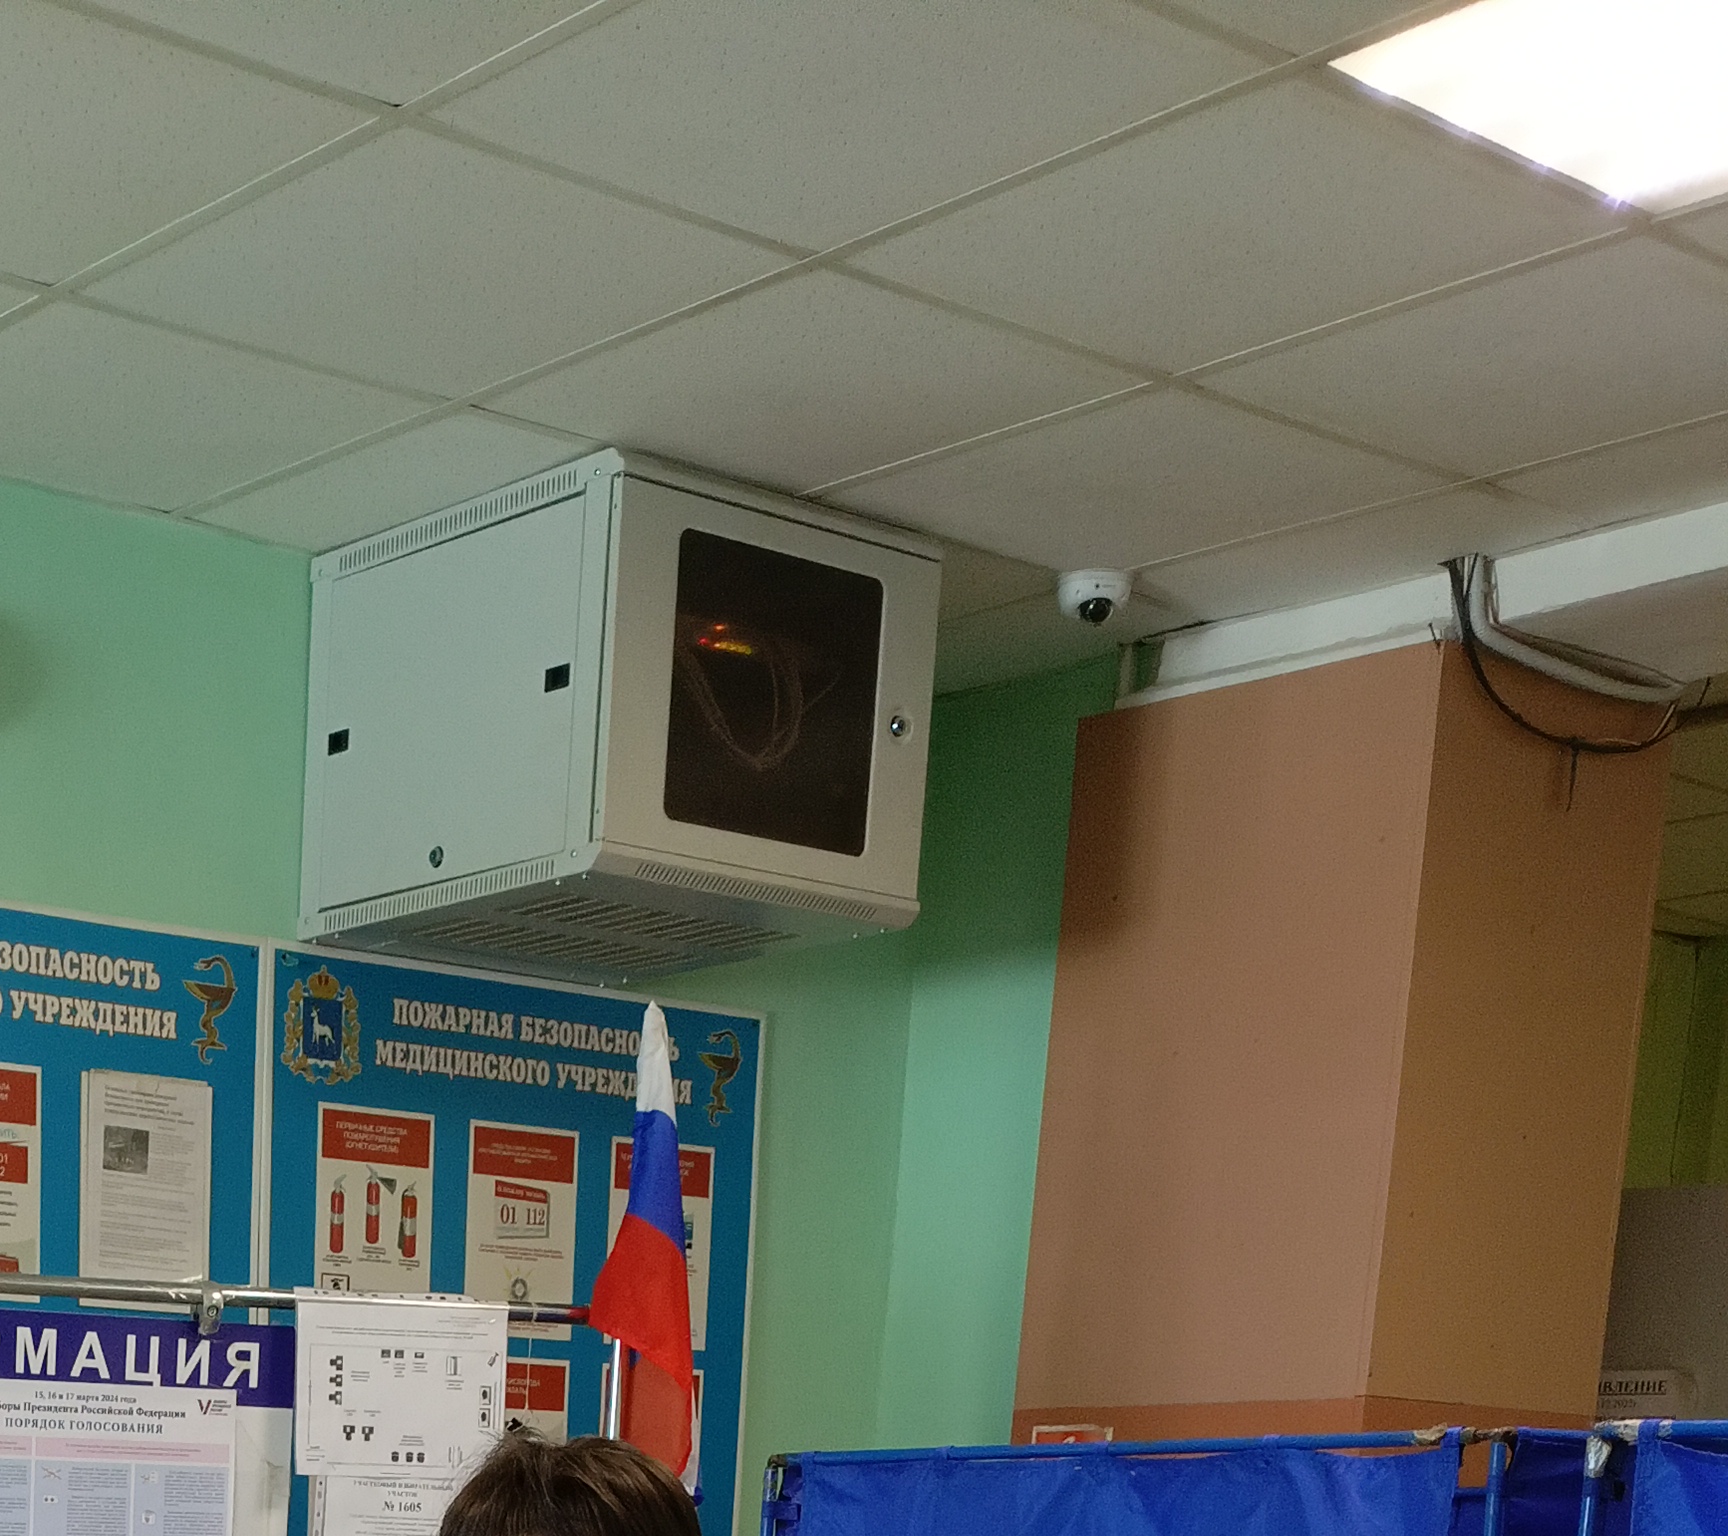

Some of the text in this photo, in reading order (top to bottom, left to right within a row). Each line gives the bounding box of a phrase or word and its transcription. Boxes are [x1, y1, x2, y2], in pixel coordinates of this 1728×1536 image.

[10, 990, 177, 1039] УЧРЕЖДЕНИЯ
[393, 998, 680, 1062] ПОЖАРНАЯ БЕЗОПАСНОЬ
[376, 1039, 693, 1105] МЕДИЦИНСКОГО УЧРЕЖДЯ
[500, 1204, 545, 1225] 01 112
[76, 1395, 99, 1403] марта
[101, 1394, 118, 1402] 2024
[24, 1402, 78, 1414] Президента
[81, 1405, 133, 1416] Российской
[136, 1407, 186, 1419] Федерации
[5, 1417, 163, 1434] ПОРЯДОК ГОЛОСОВАНИЯ
[382, 1500, 422, 1513] № 1605
